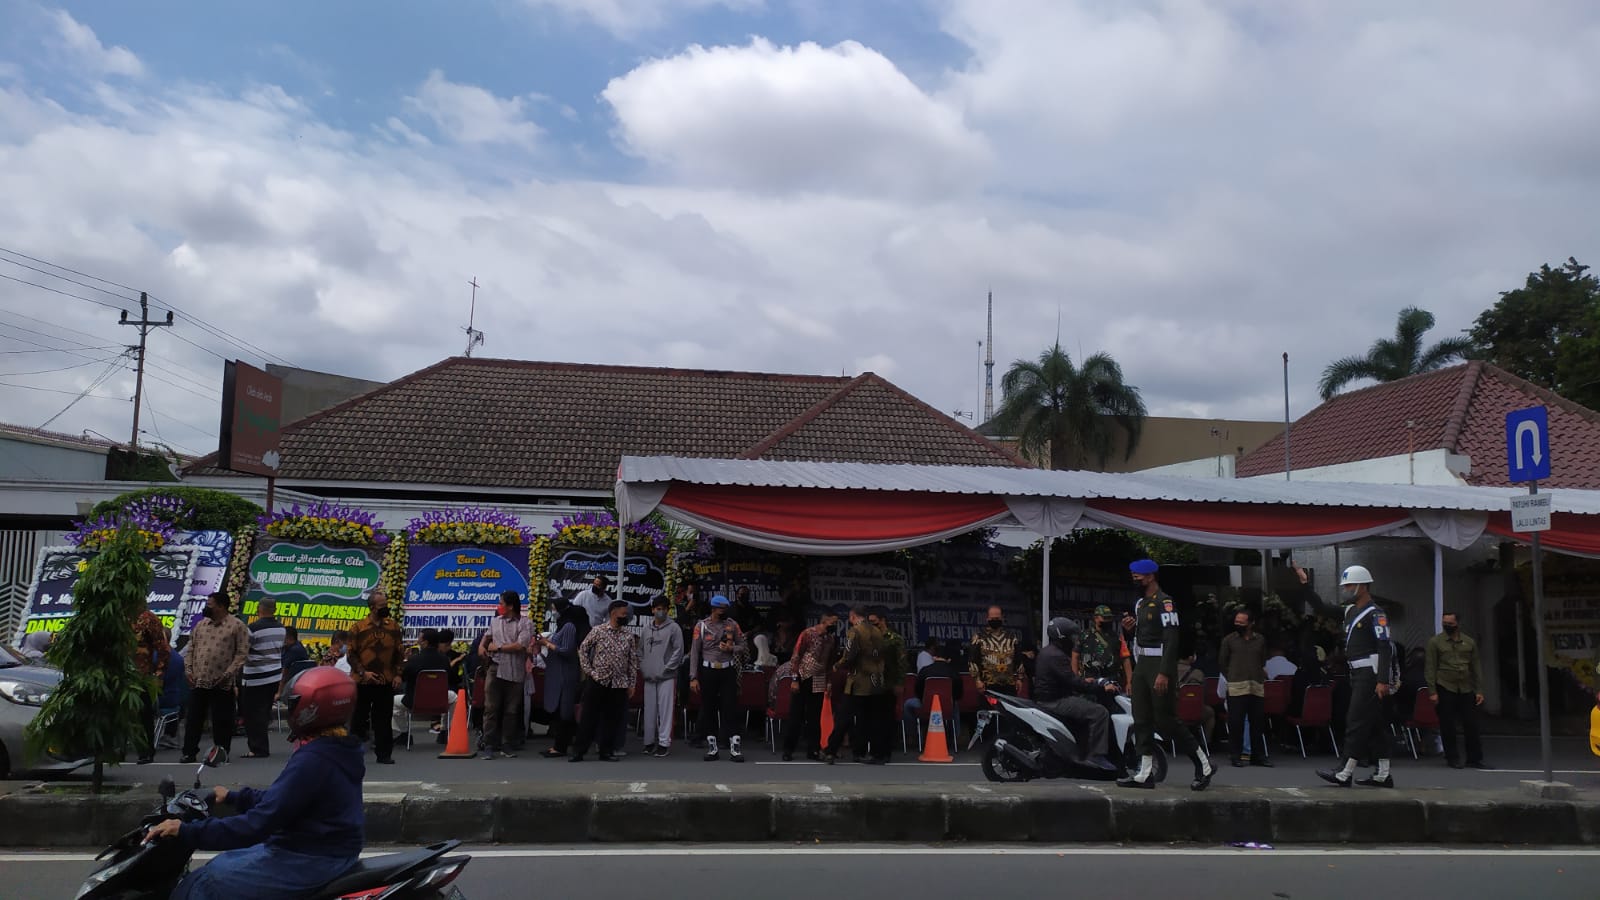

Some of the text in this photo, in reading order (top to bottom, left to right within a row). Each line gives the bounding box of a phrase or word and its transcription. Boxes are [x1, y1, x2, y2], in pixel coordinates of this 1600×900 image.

[267, 552, 365, 567] Turut Berduka Cita
[456, 554, 487, 565] Turut
[434, 568, 502, 579] Berduka Cita
[420, 590, 455, 602] Miyono
[1160, 612, 1180, 627] PM
